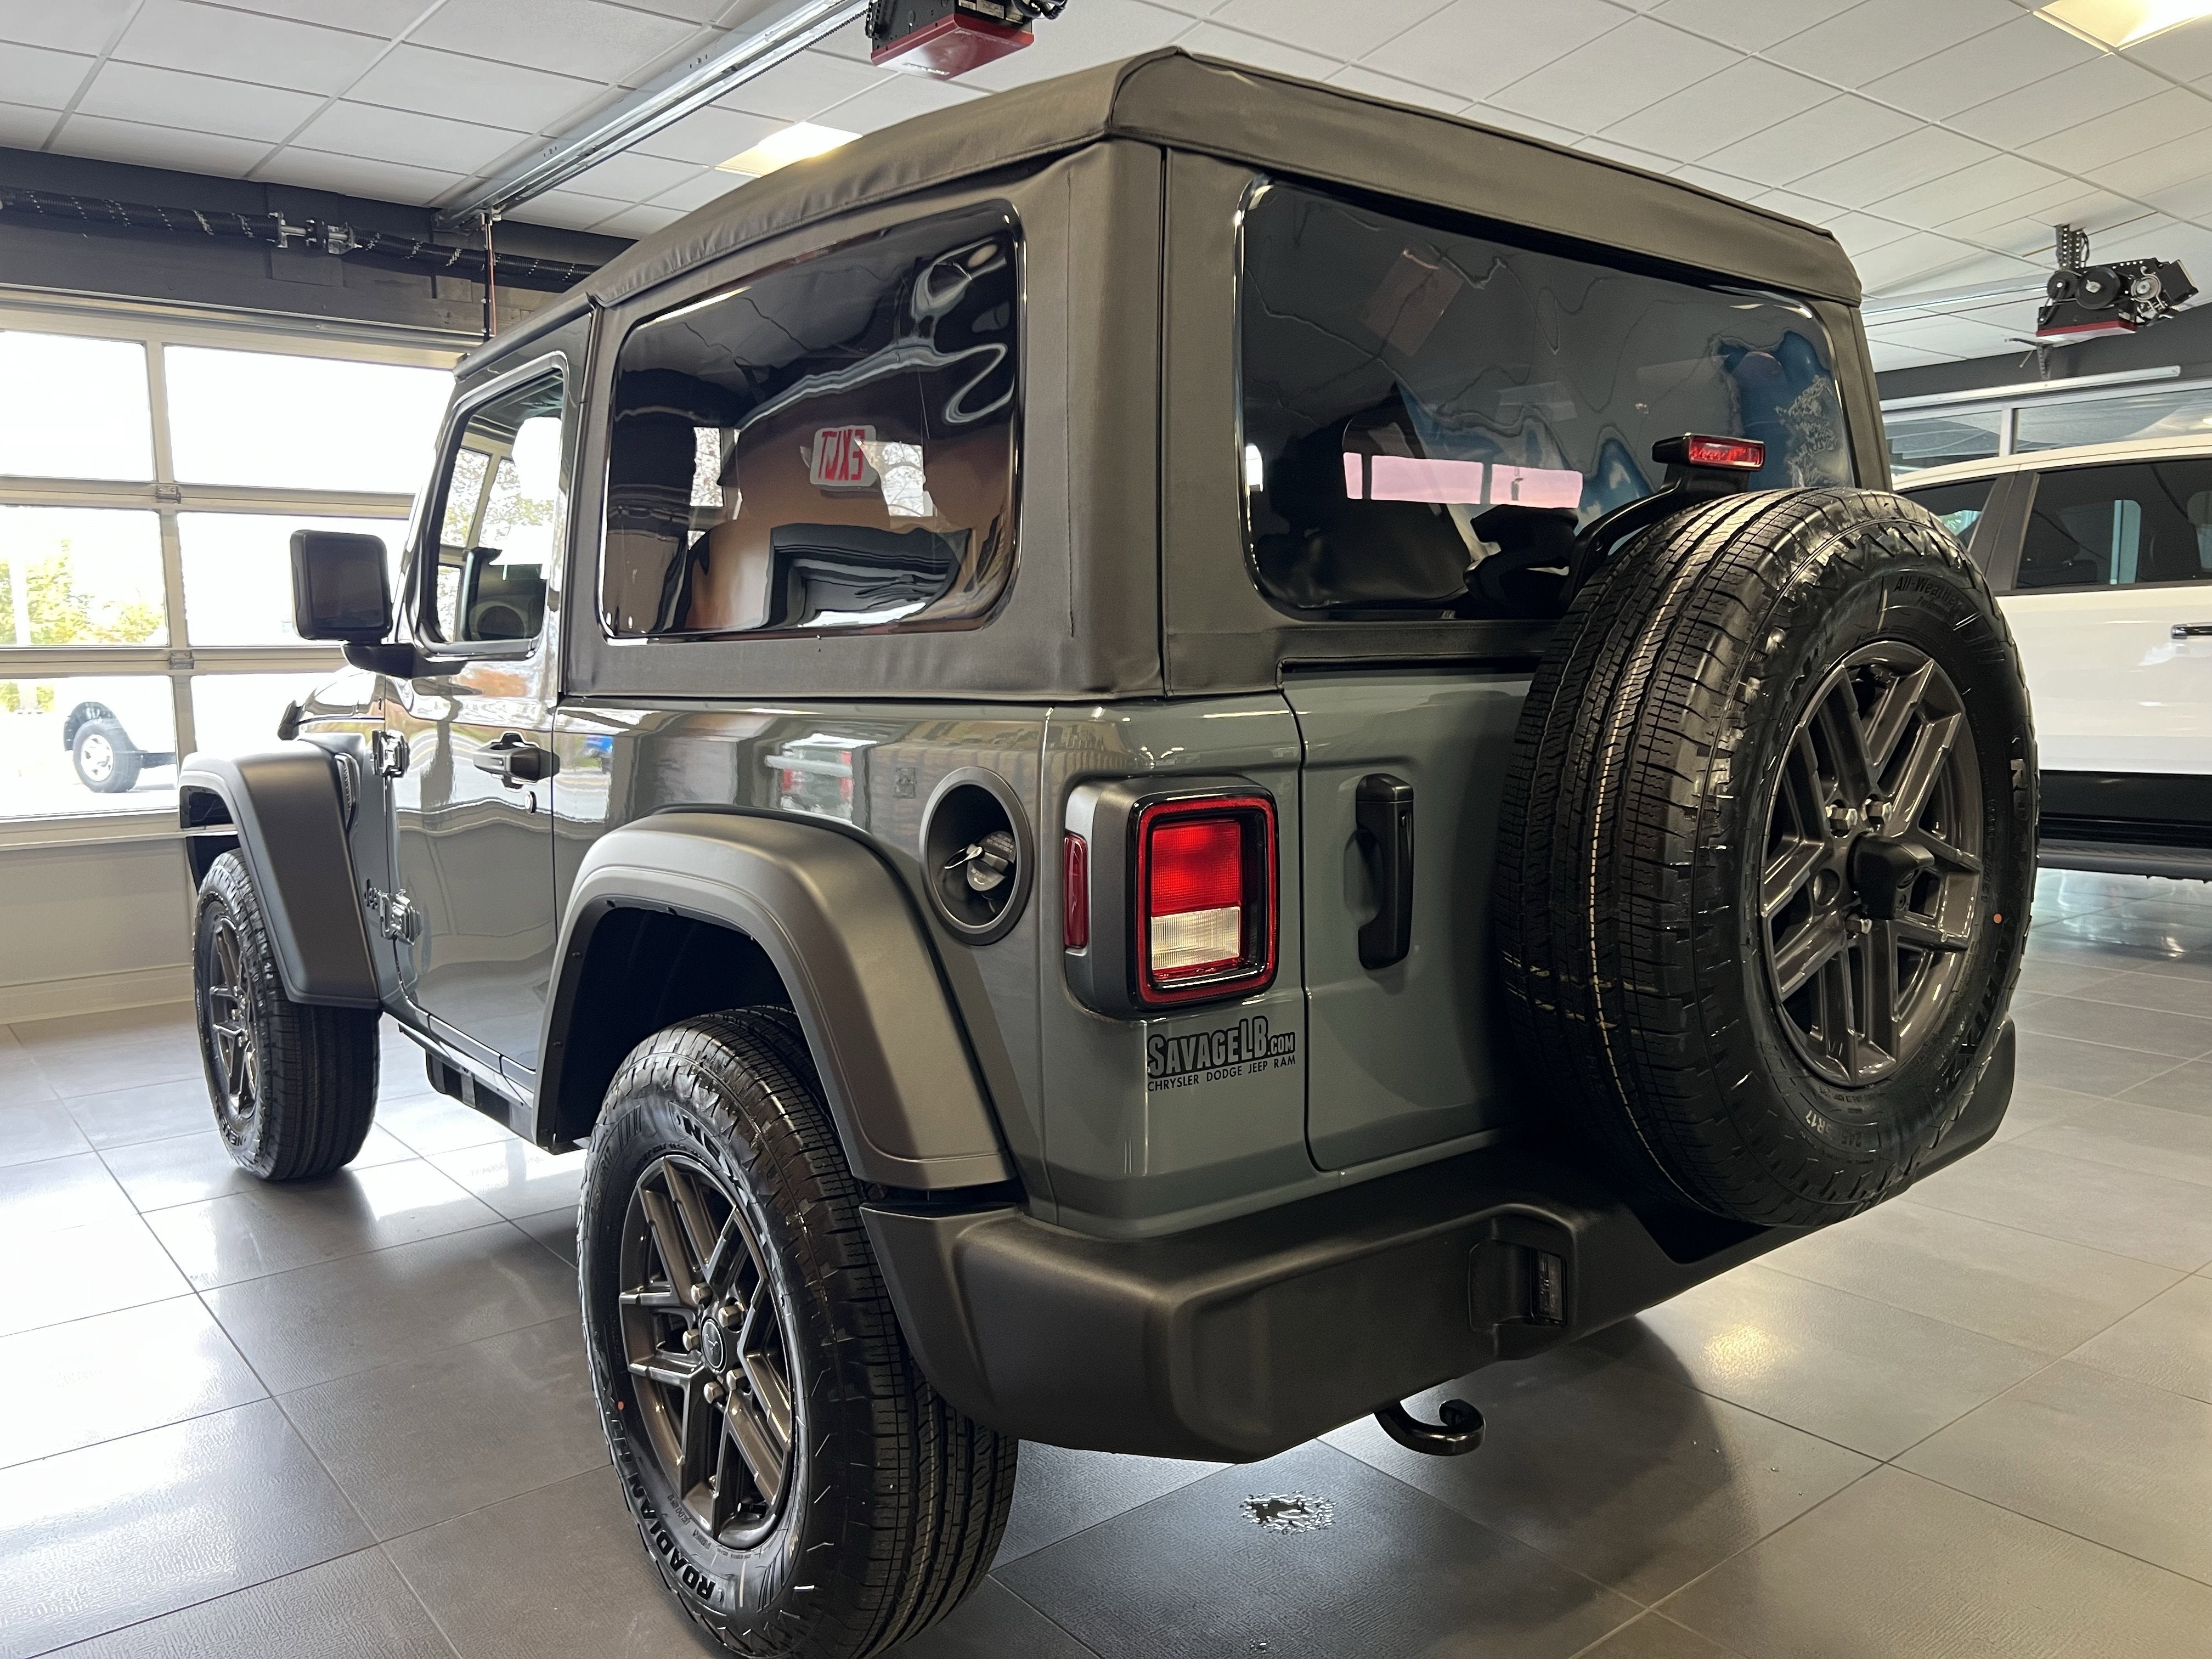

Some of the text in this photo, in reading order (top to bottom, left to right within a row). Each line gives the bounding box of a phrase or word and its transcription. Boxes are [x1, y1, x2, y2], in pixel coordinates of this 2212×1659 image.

[1148, 1055, 1296, 1092] CHRYSLER DODGE JEEP RAM
[627, 1472, 715, 1600] ROADIAN
